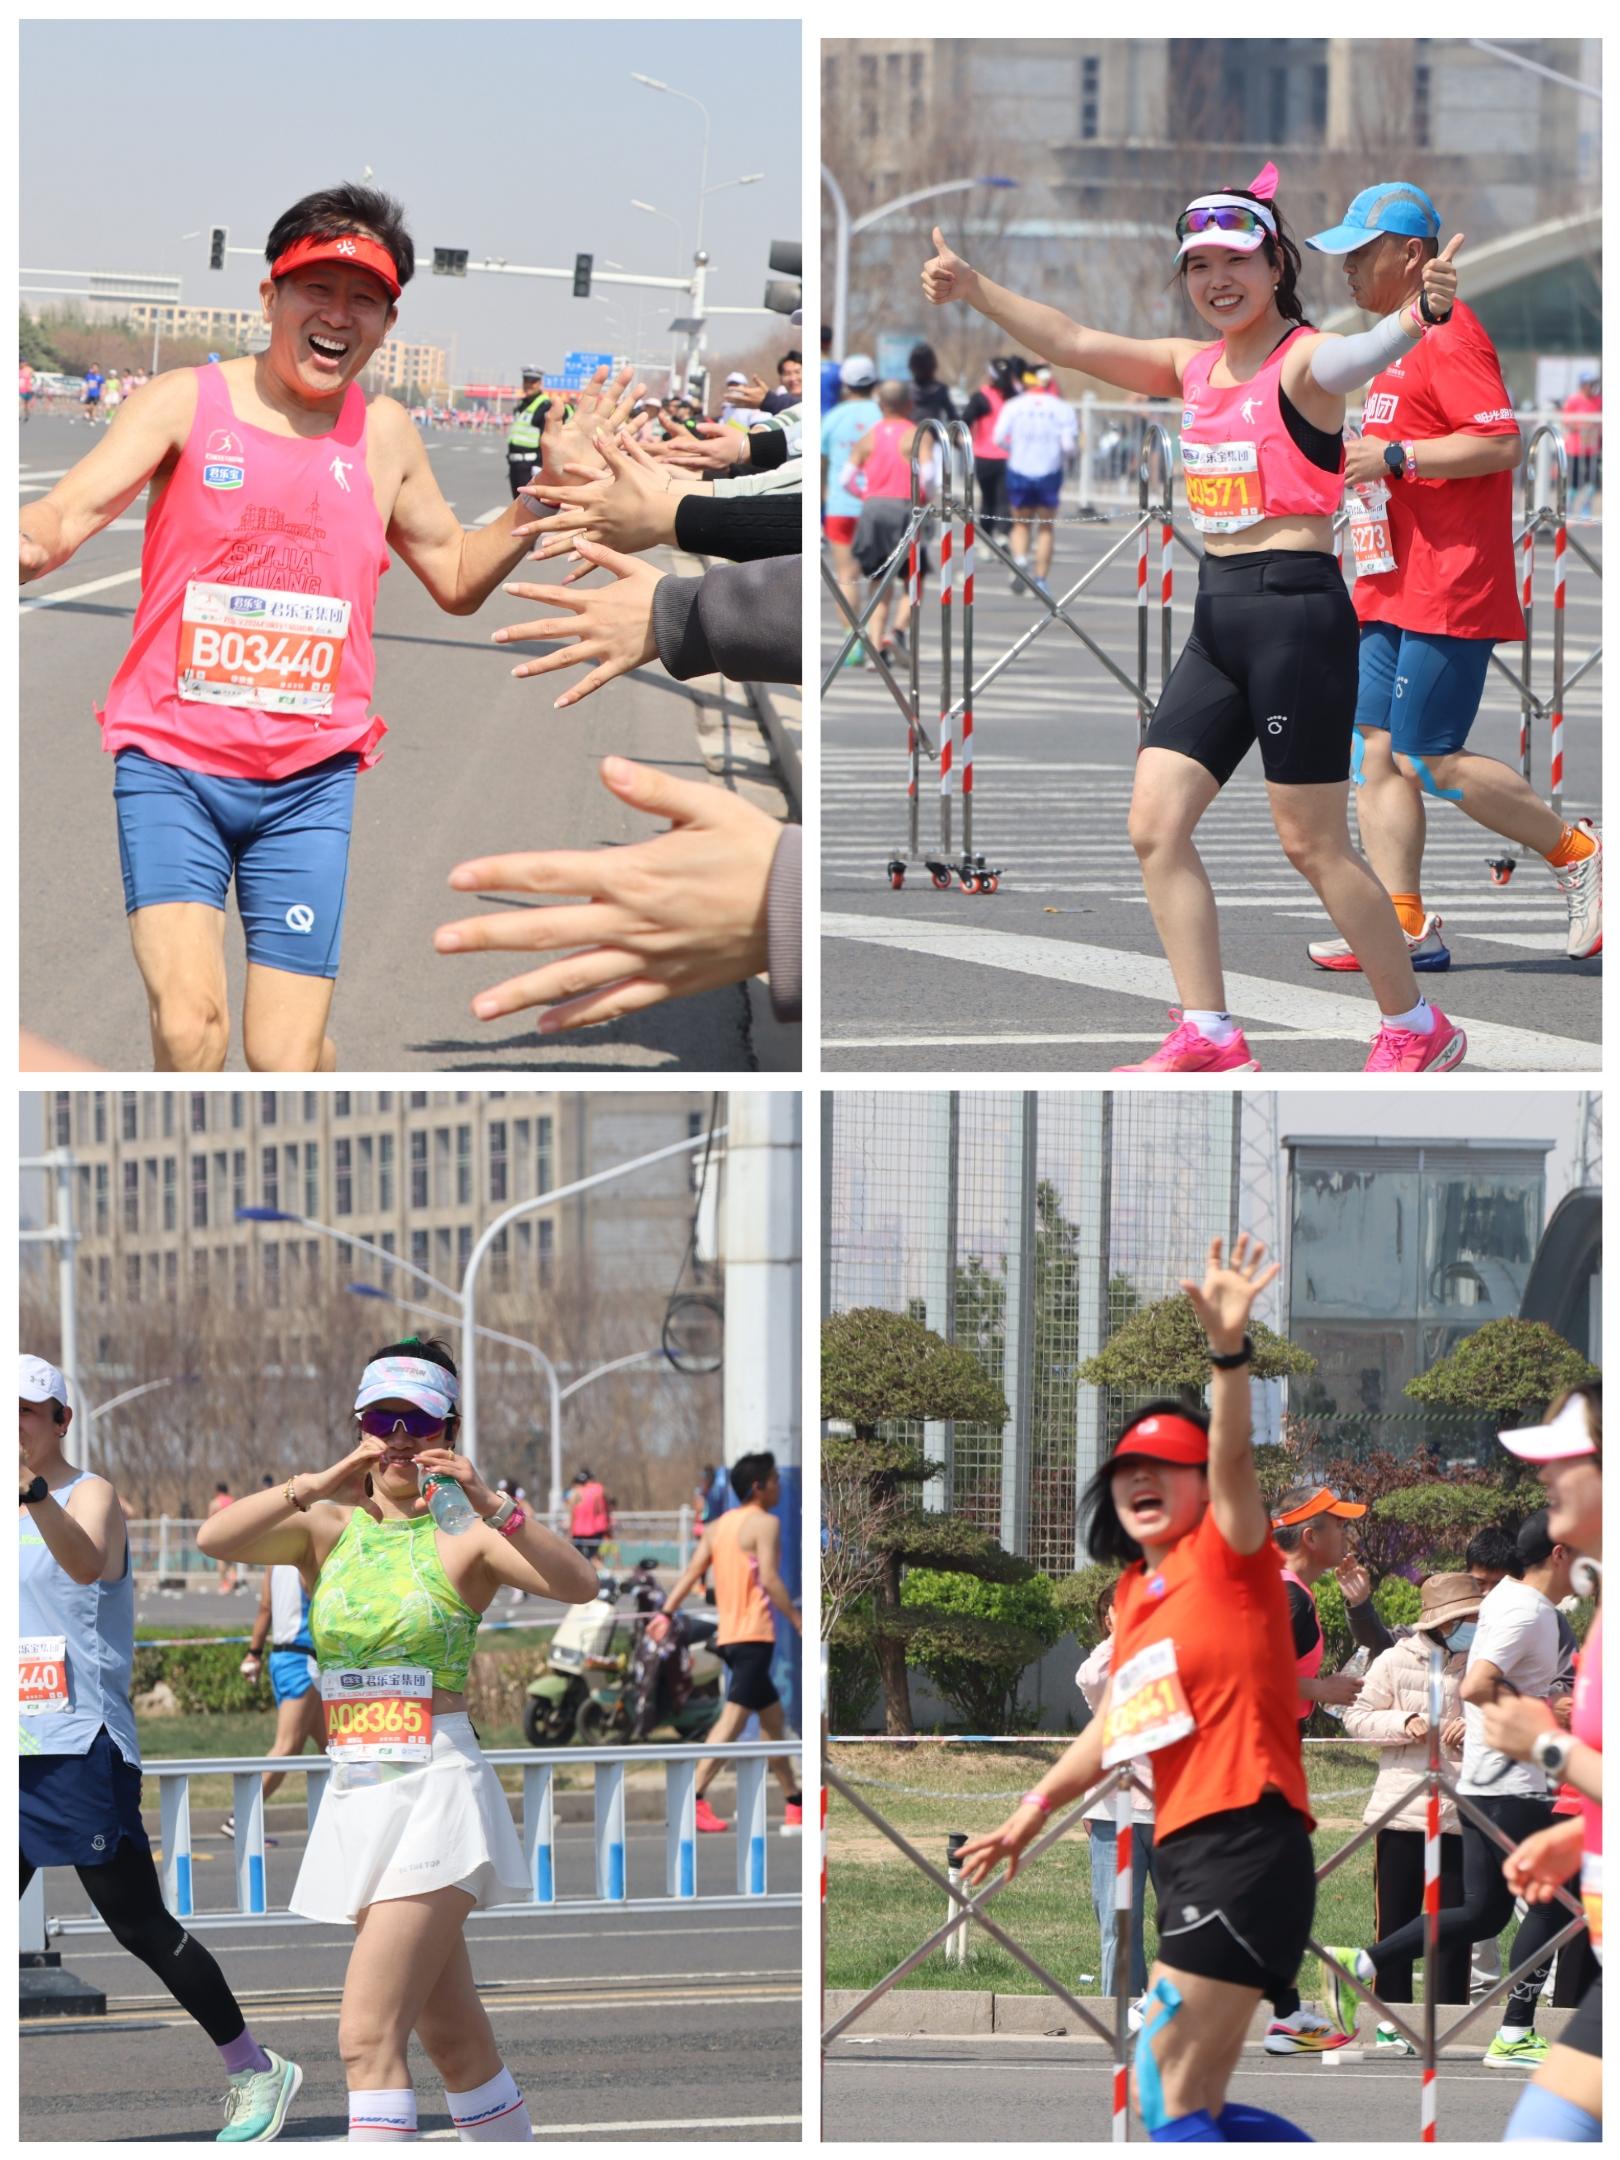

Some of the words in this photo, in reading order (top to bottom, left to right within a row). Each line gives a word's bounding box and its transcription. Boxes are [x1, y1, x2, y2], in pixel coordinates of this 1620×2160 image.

[221, 542, 314, 575] SHIJIA
[271, 601, 343, 624] 君乐宝集团
[191, 627, 334, 680] B03440
[366, 1673, 426, 1687] 君乐宝集团
[328, 1700, 423, 1735] A08365
